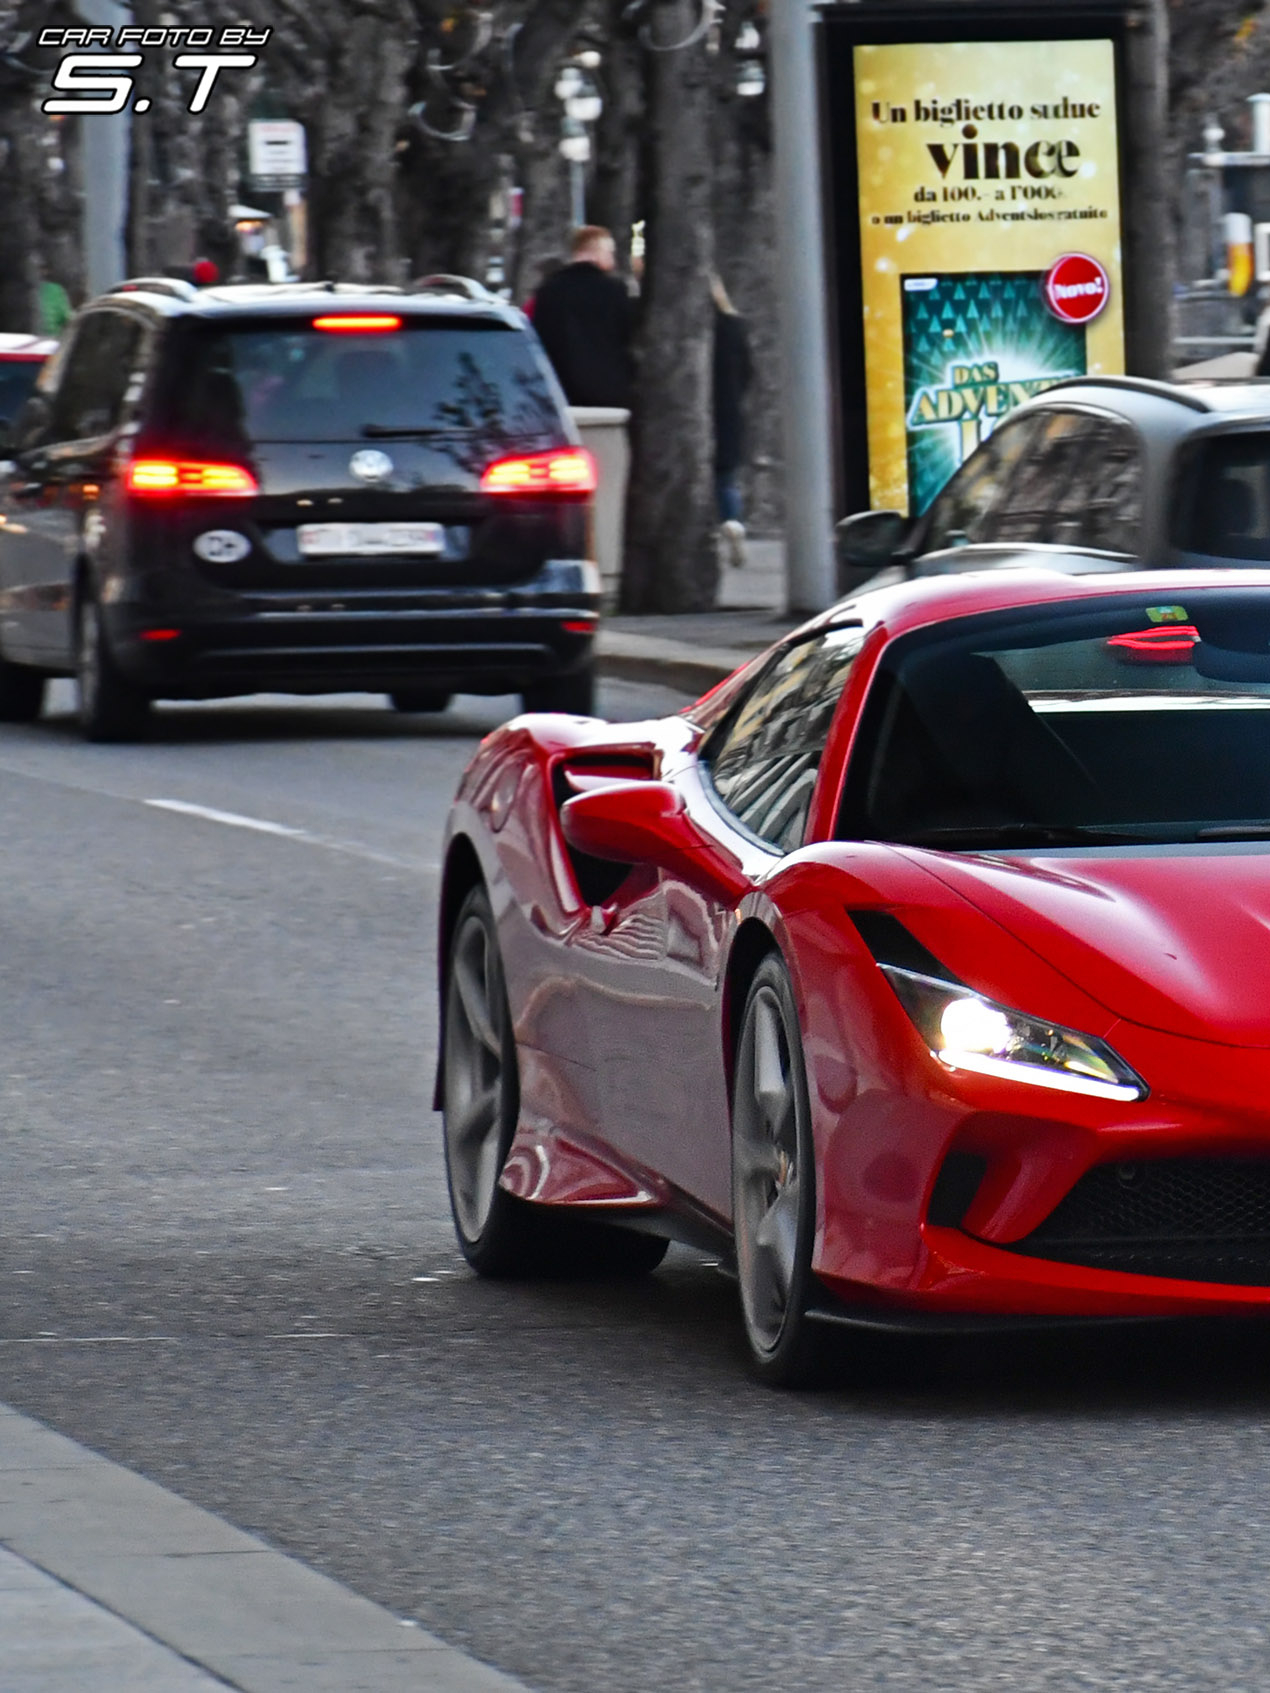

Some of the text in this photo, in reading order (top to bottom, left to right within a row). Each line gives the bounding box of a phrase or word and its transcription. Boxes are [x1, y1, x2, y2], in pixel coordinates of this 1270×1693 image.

[872, 101, 907, 123] Un
[914, 98, 1023, 127] biglietto
[926, 123, 1081, 180] vince
[914, 185, 937, 202] da
[995, 188, 1006, 201] a
[907, 208, 971, 226] biglietto
[953, 363, 998, 386] DAS
